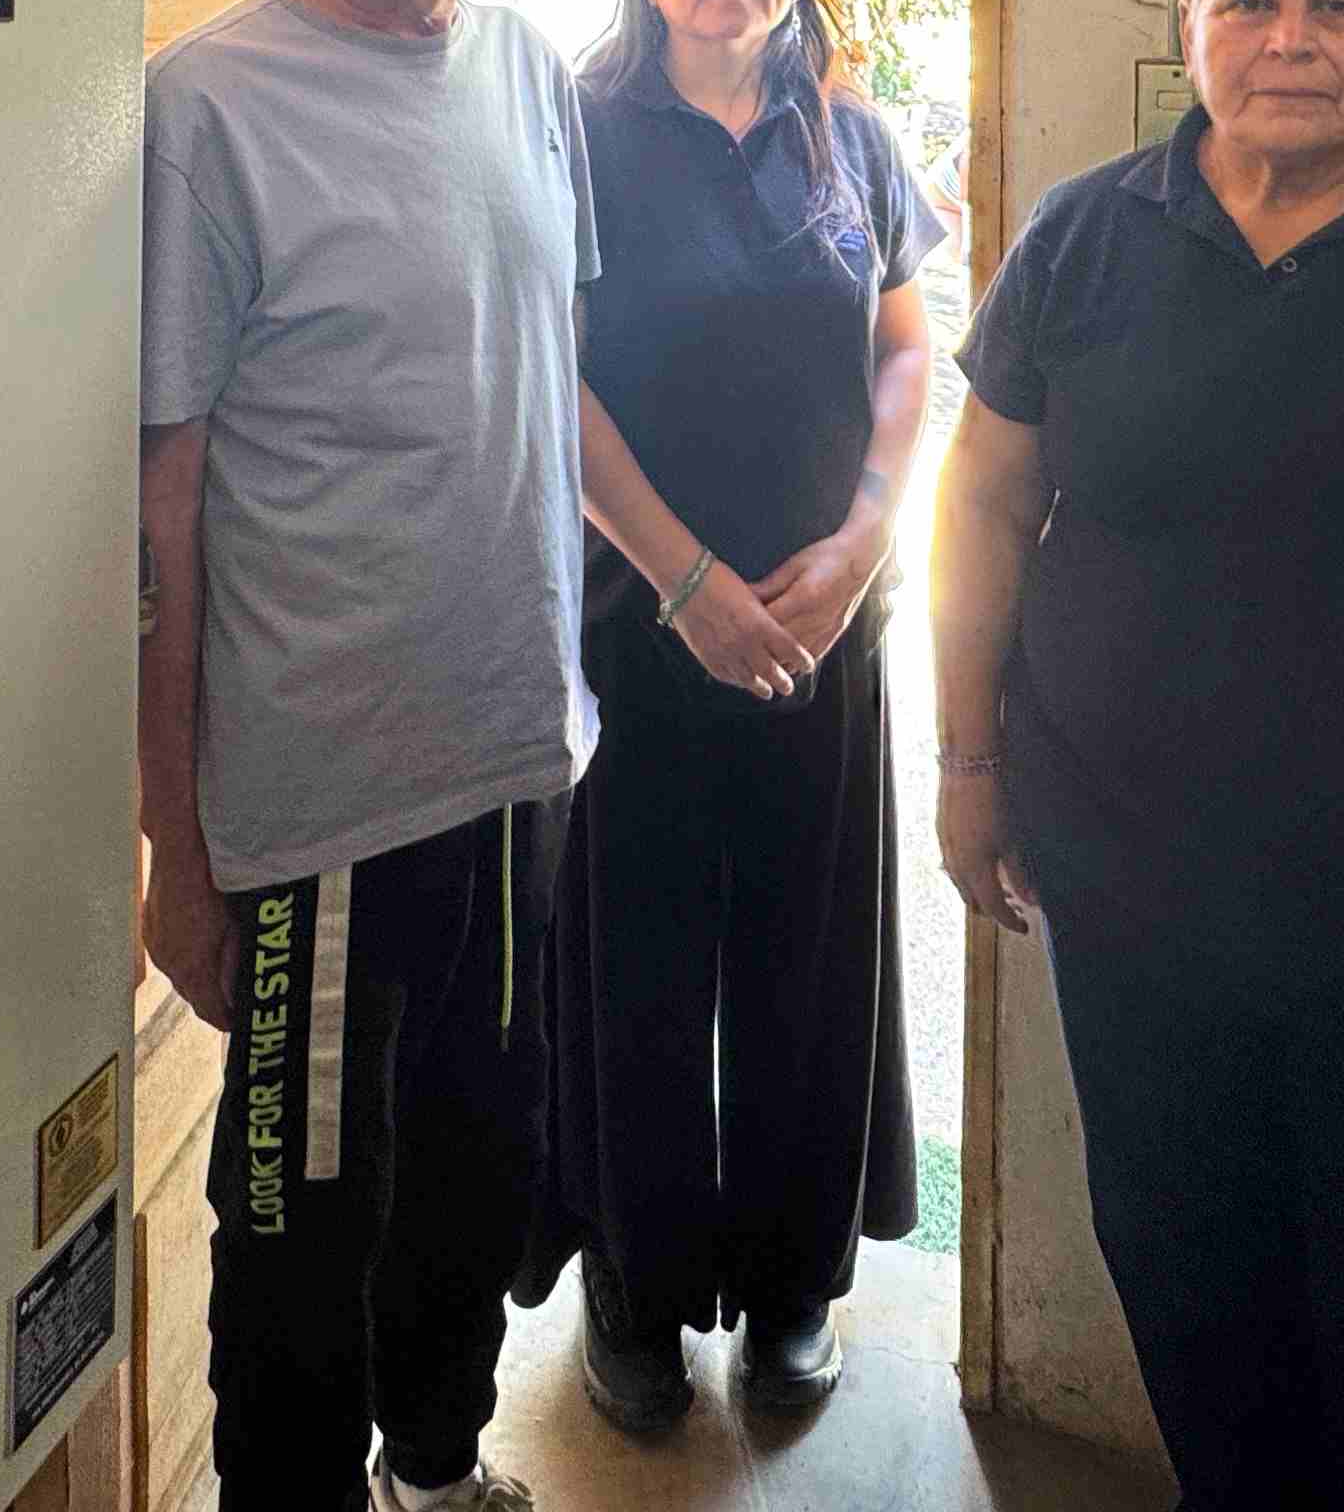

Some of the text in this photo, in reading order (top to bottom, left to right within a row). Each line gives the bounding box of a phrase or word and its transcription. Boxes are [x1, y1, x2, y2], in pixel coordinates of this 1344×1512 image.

[248, 892, 295, 1234] LOOK FOR THE STAR
